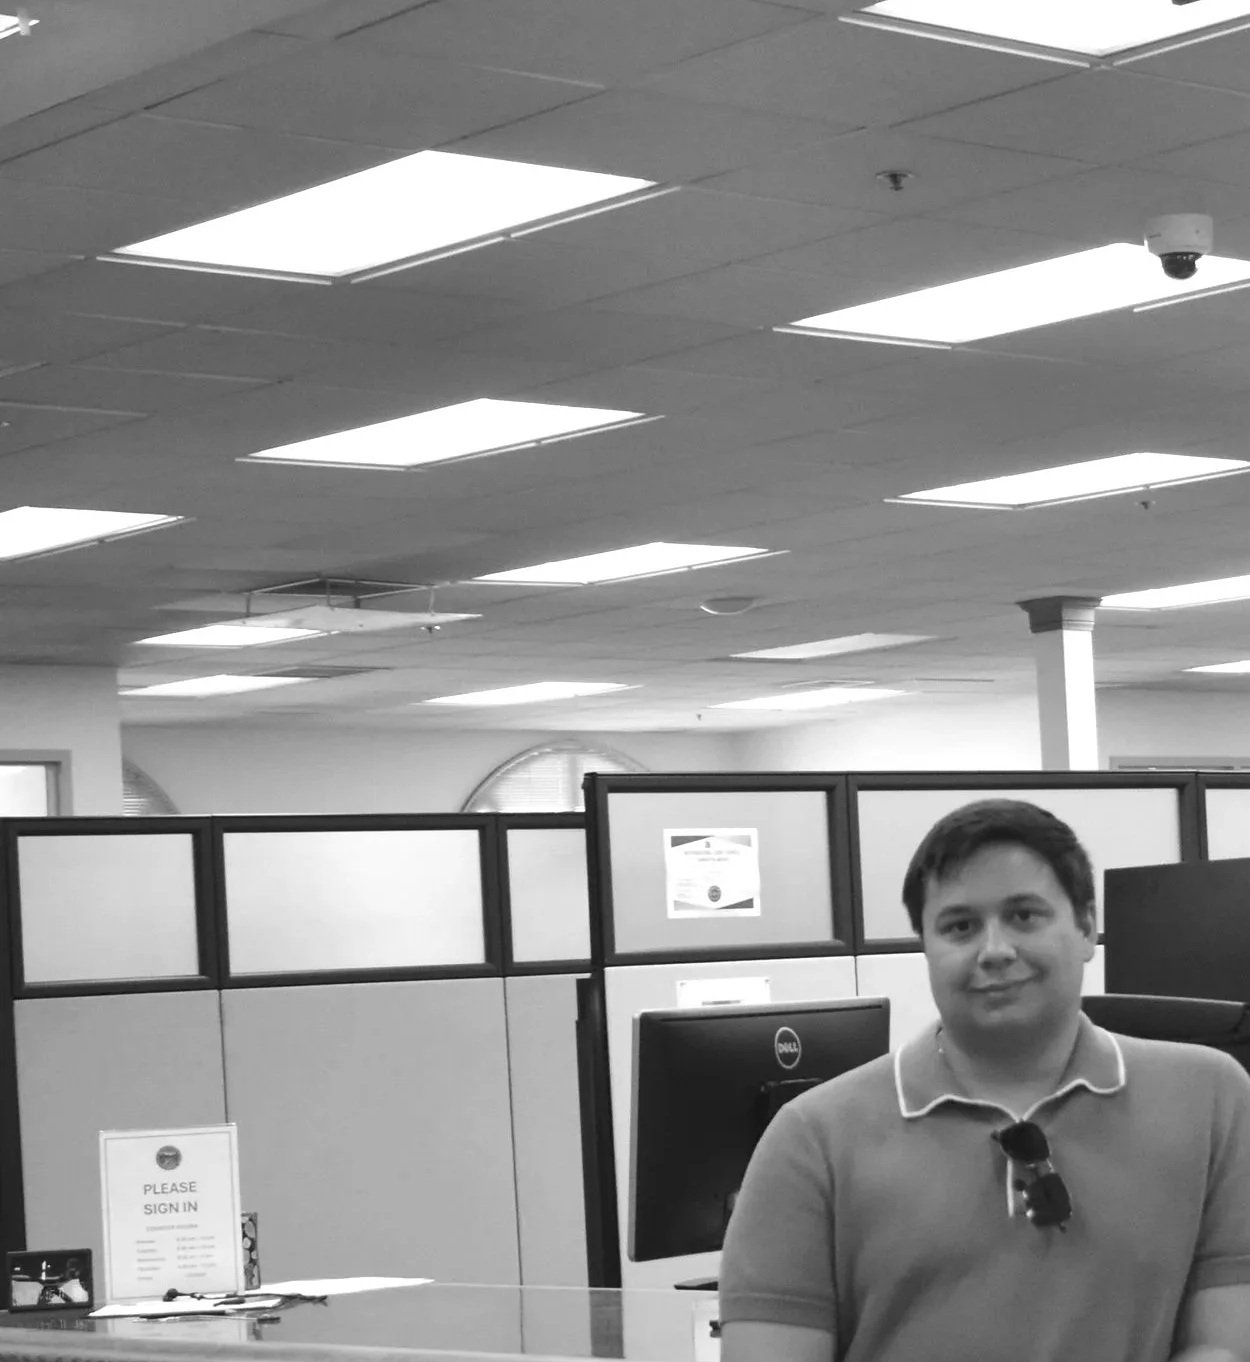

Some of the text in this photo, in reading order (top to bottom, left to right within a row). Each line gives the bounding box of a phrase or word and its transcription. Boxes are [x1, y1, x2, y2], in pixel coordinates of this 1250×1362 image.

[778, 1042, 798, 1054] DELL
[144, 1181, 198, 1195] PLEASE
[144, 1201, 198, 1215] SIGN IN
